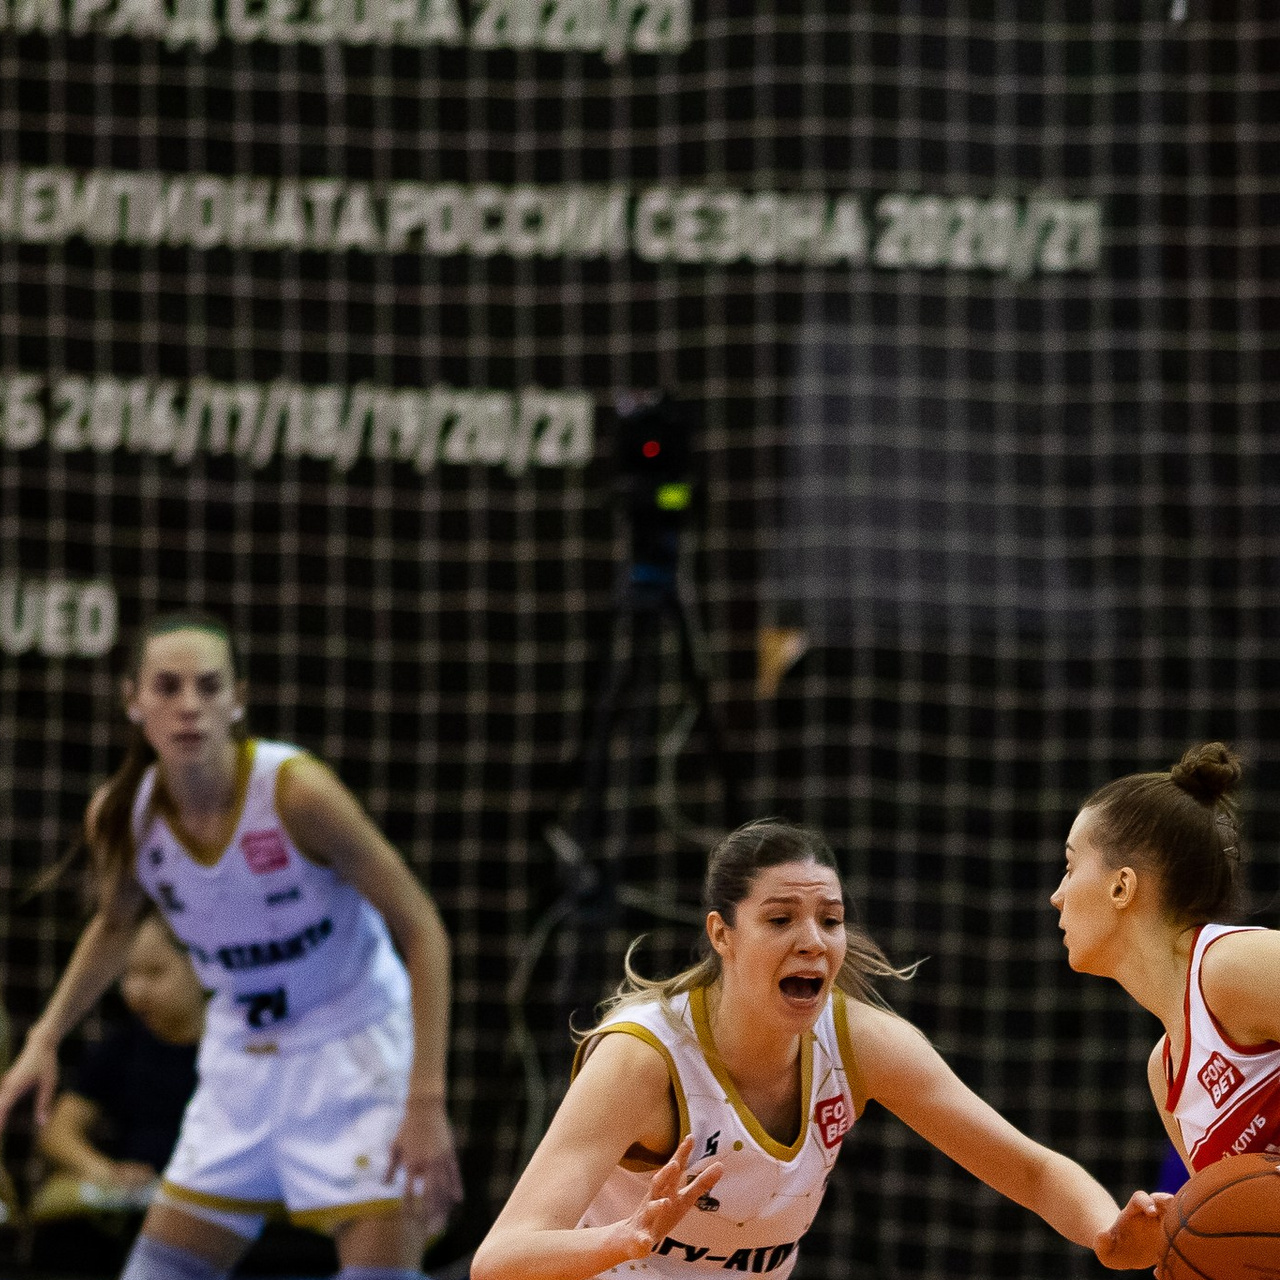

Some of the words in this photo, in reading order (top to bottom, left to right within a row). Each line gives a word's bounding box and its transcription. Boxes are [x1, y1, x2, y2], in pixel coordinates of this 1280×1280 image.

[386, 182, 630, 258] РОССИИ
[634, 188, 870, 264] СЕЗОНА
[874, 195, 1100, 280] 2020/21
[1202, 1055, 1227, 1090] FON
[1211, 1066, 1236, 1104] BET
[821, 1100, 846, 1125] FO
[826, 1116, 850, 1143] BE
[1231, 1114, 1266, 1156] КЛУБ
[651, 1236, 796, 1274] ГУ-АТЛ
